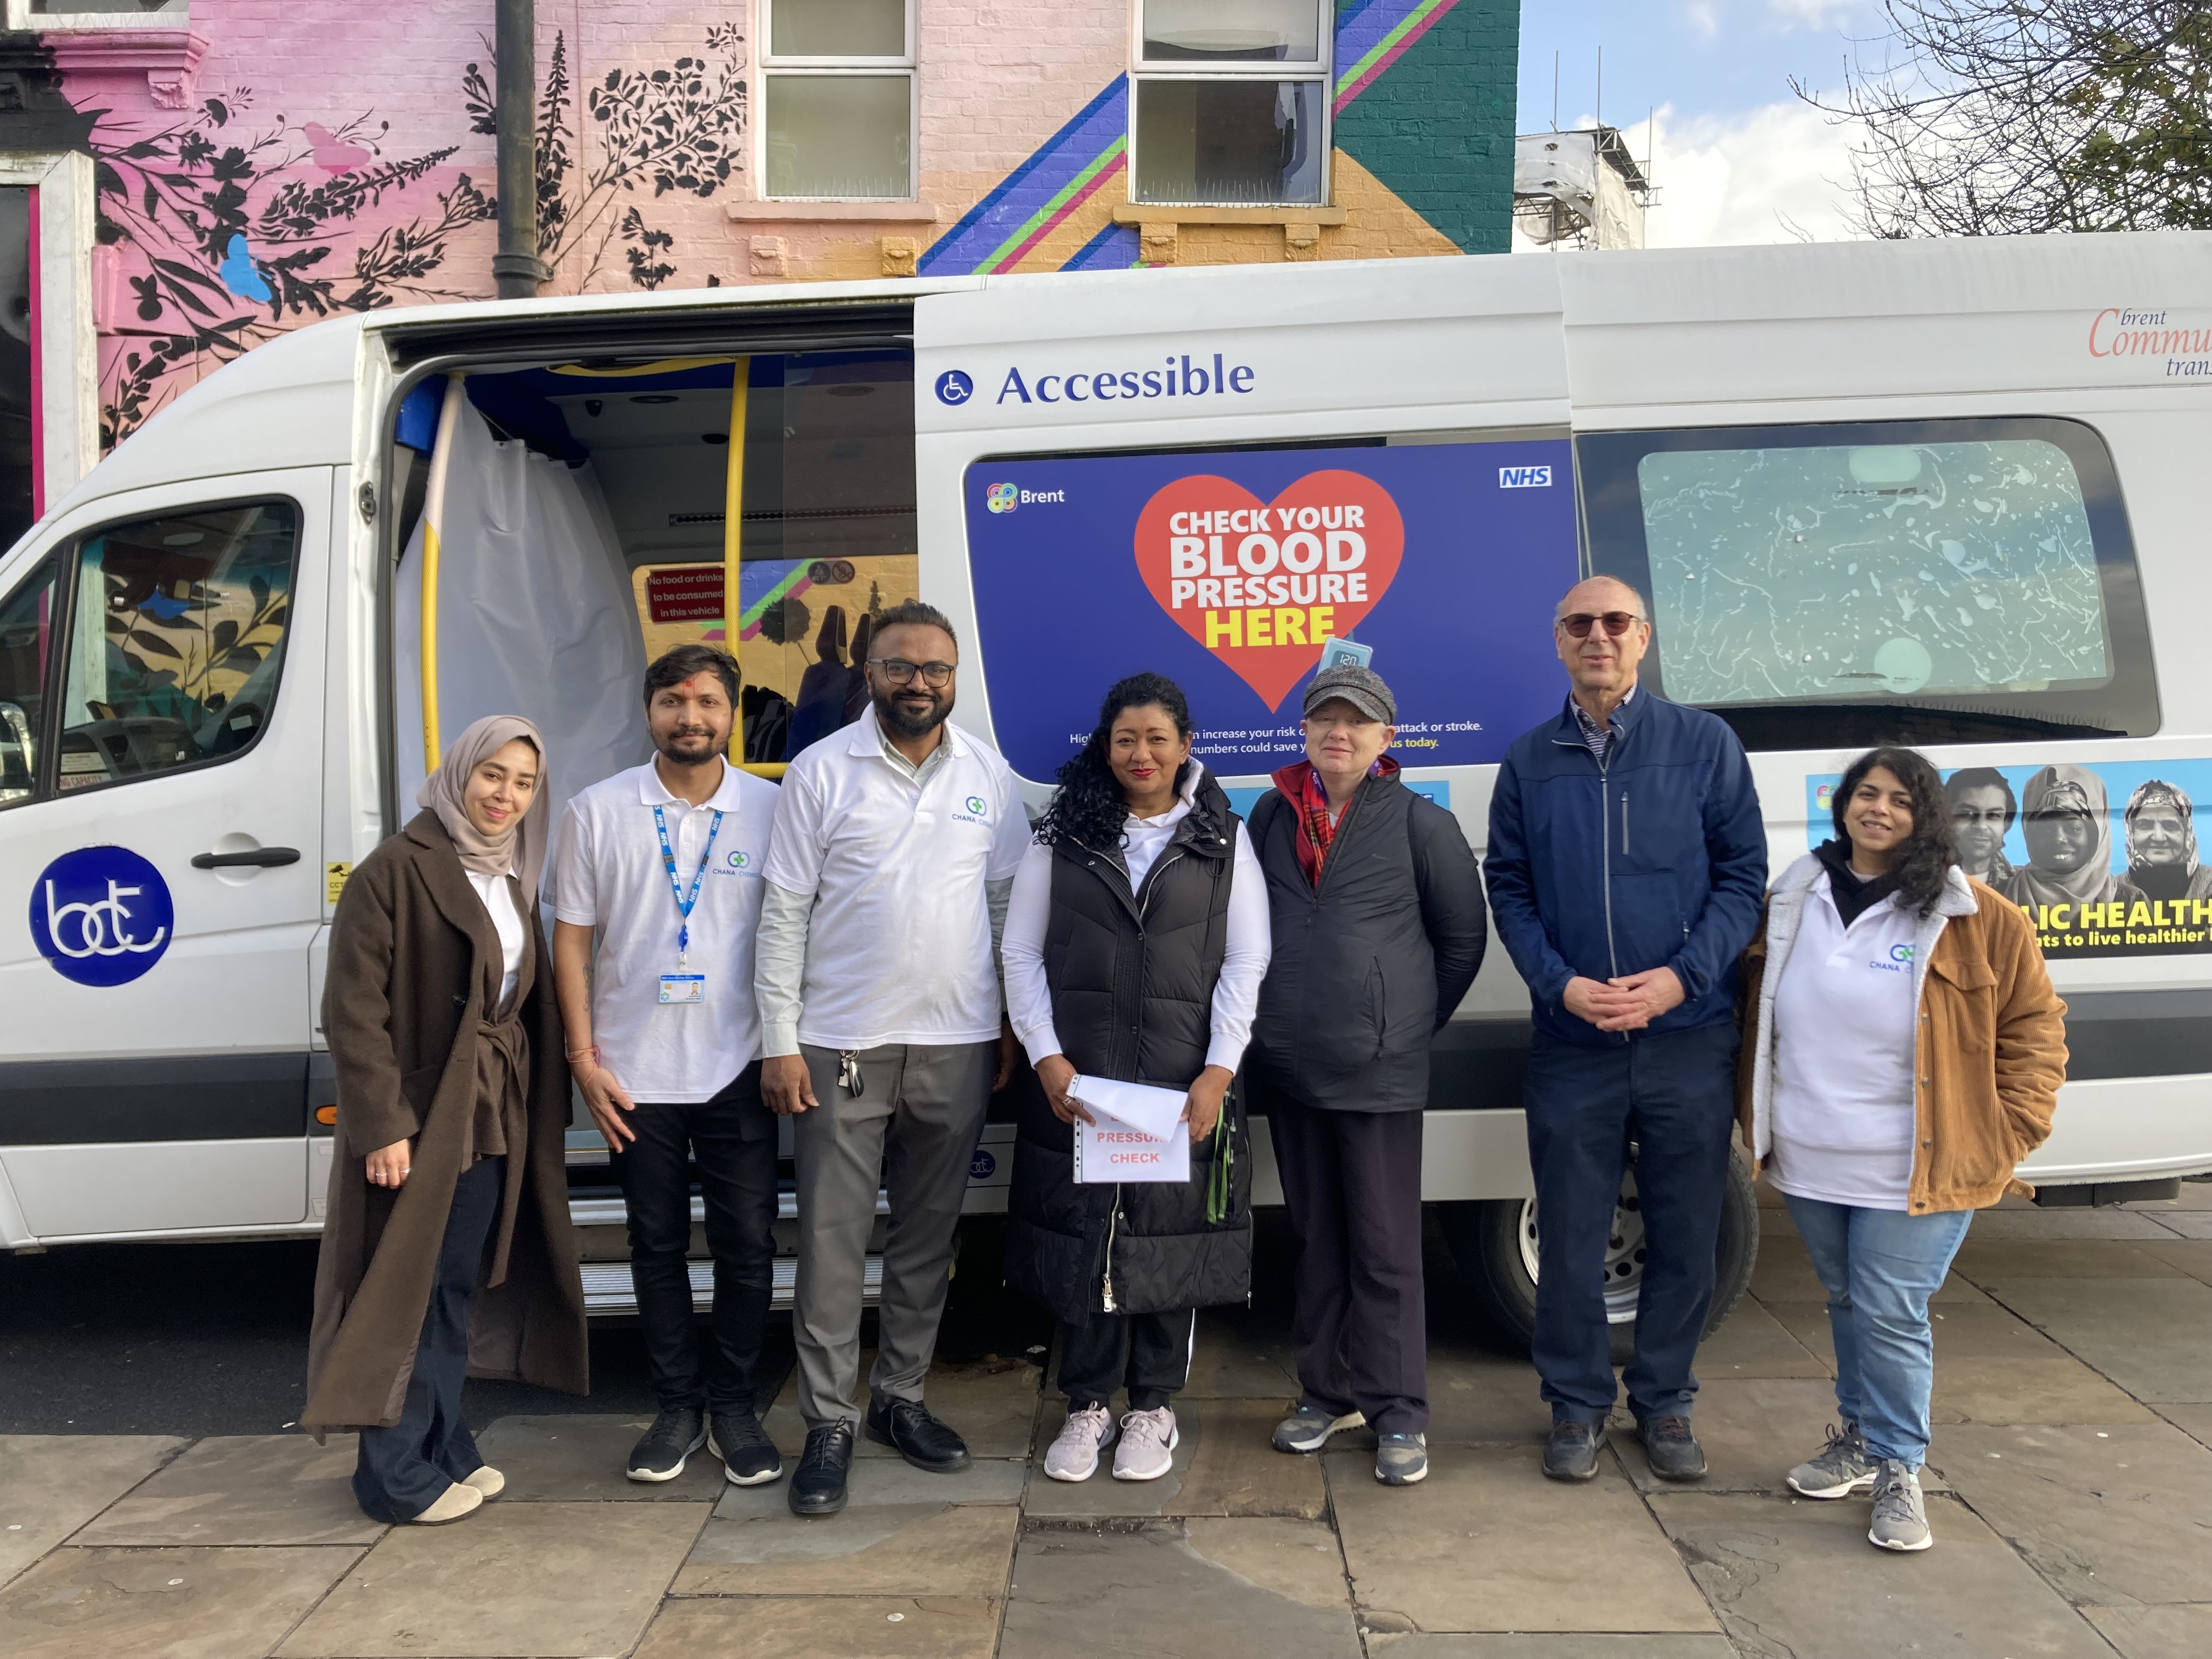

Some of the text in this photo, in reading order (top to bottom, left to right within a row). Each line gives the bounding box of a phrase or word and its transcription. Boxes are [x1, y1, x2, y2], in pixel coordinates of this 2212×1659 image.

[2121, 308, 2168, 326] brent
[2166, 358, 2212, 376] tran
[996, 353, 1255, 405] Accessible
[1501, 467, 1549, 486] NHS
[1020, 489, 1065, 504] Brent
[1169, 505, 1365, 535] CHECK YOUR
[1170, 531, 1367, 578] BLOOD
[663, 575, 684, 584] food
[696, 573, 724, 582] drinks
[663, 592, 675, 601] be
[676, 590, 724, 601] consumed
[1171, 572, 1368, 609] PRESSURE
[660, 606, 720, 618] in this vehicle
[1205, 606, 1335, 648] HERE
[1202, 729, 1246, 740] increase
[1249, 729, 1274, 741] your
[1277, 726, 1296, 737] risk
[1395, 720, 1483, 733] attack or stroke.
[1190, 743, 1238, 754] numbers
[1240, 742, 1271, 753] could
[1273, 743, 1297, 752] save
[1404, 737, 1439, 750] today.
[656, 814, 664, 828] NHS
[711, 817, 720, 831] NHS
[952, 814, 976, 823] CHANA
[659, 832, 668, 846] NHS
[670, 872, 680, 886] NHS
[695, 871, 703, 885] NHS
[675, 890, 684, 904] NHS
[689, 888, 698, 903] NHS
[2080, 899, 2212, 929] HEALTH
[2063, 933, 2084, 947] to
[2088, 930, 2121, 946] live
[2125, 928, 2205, 945] healthier
[1870, 961, 1900, 972] CHANA
[1097, 1132, 1172, 1143] PRESSU
[1109, 1153, 1160, 1164] CHECK
